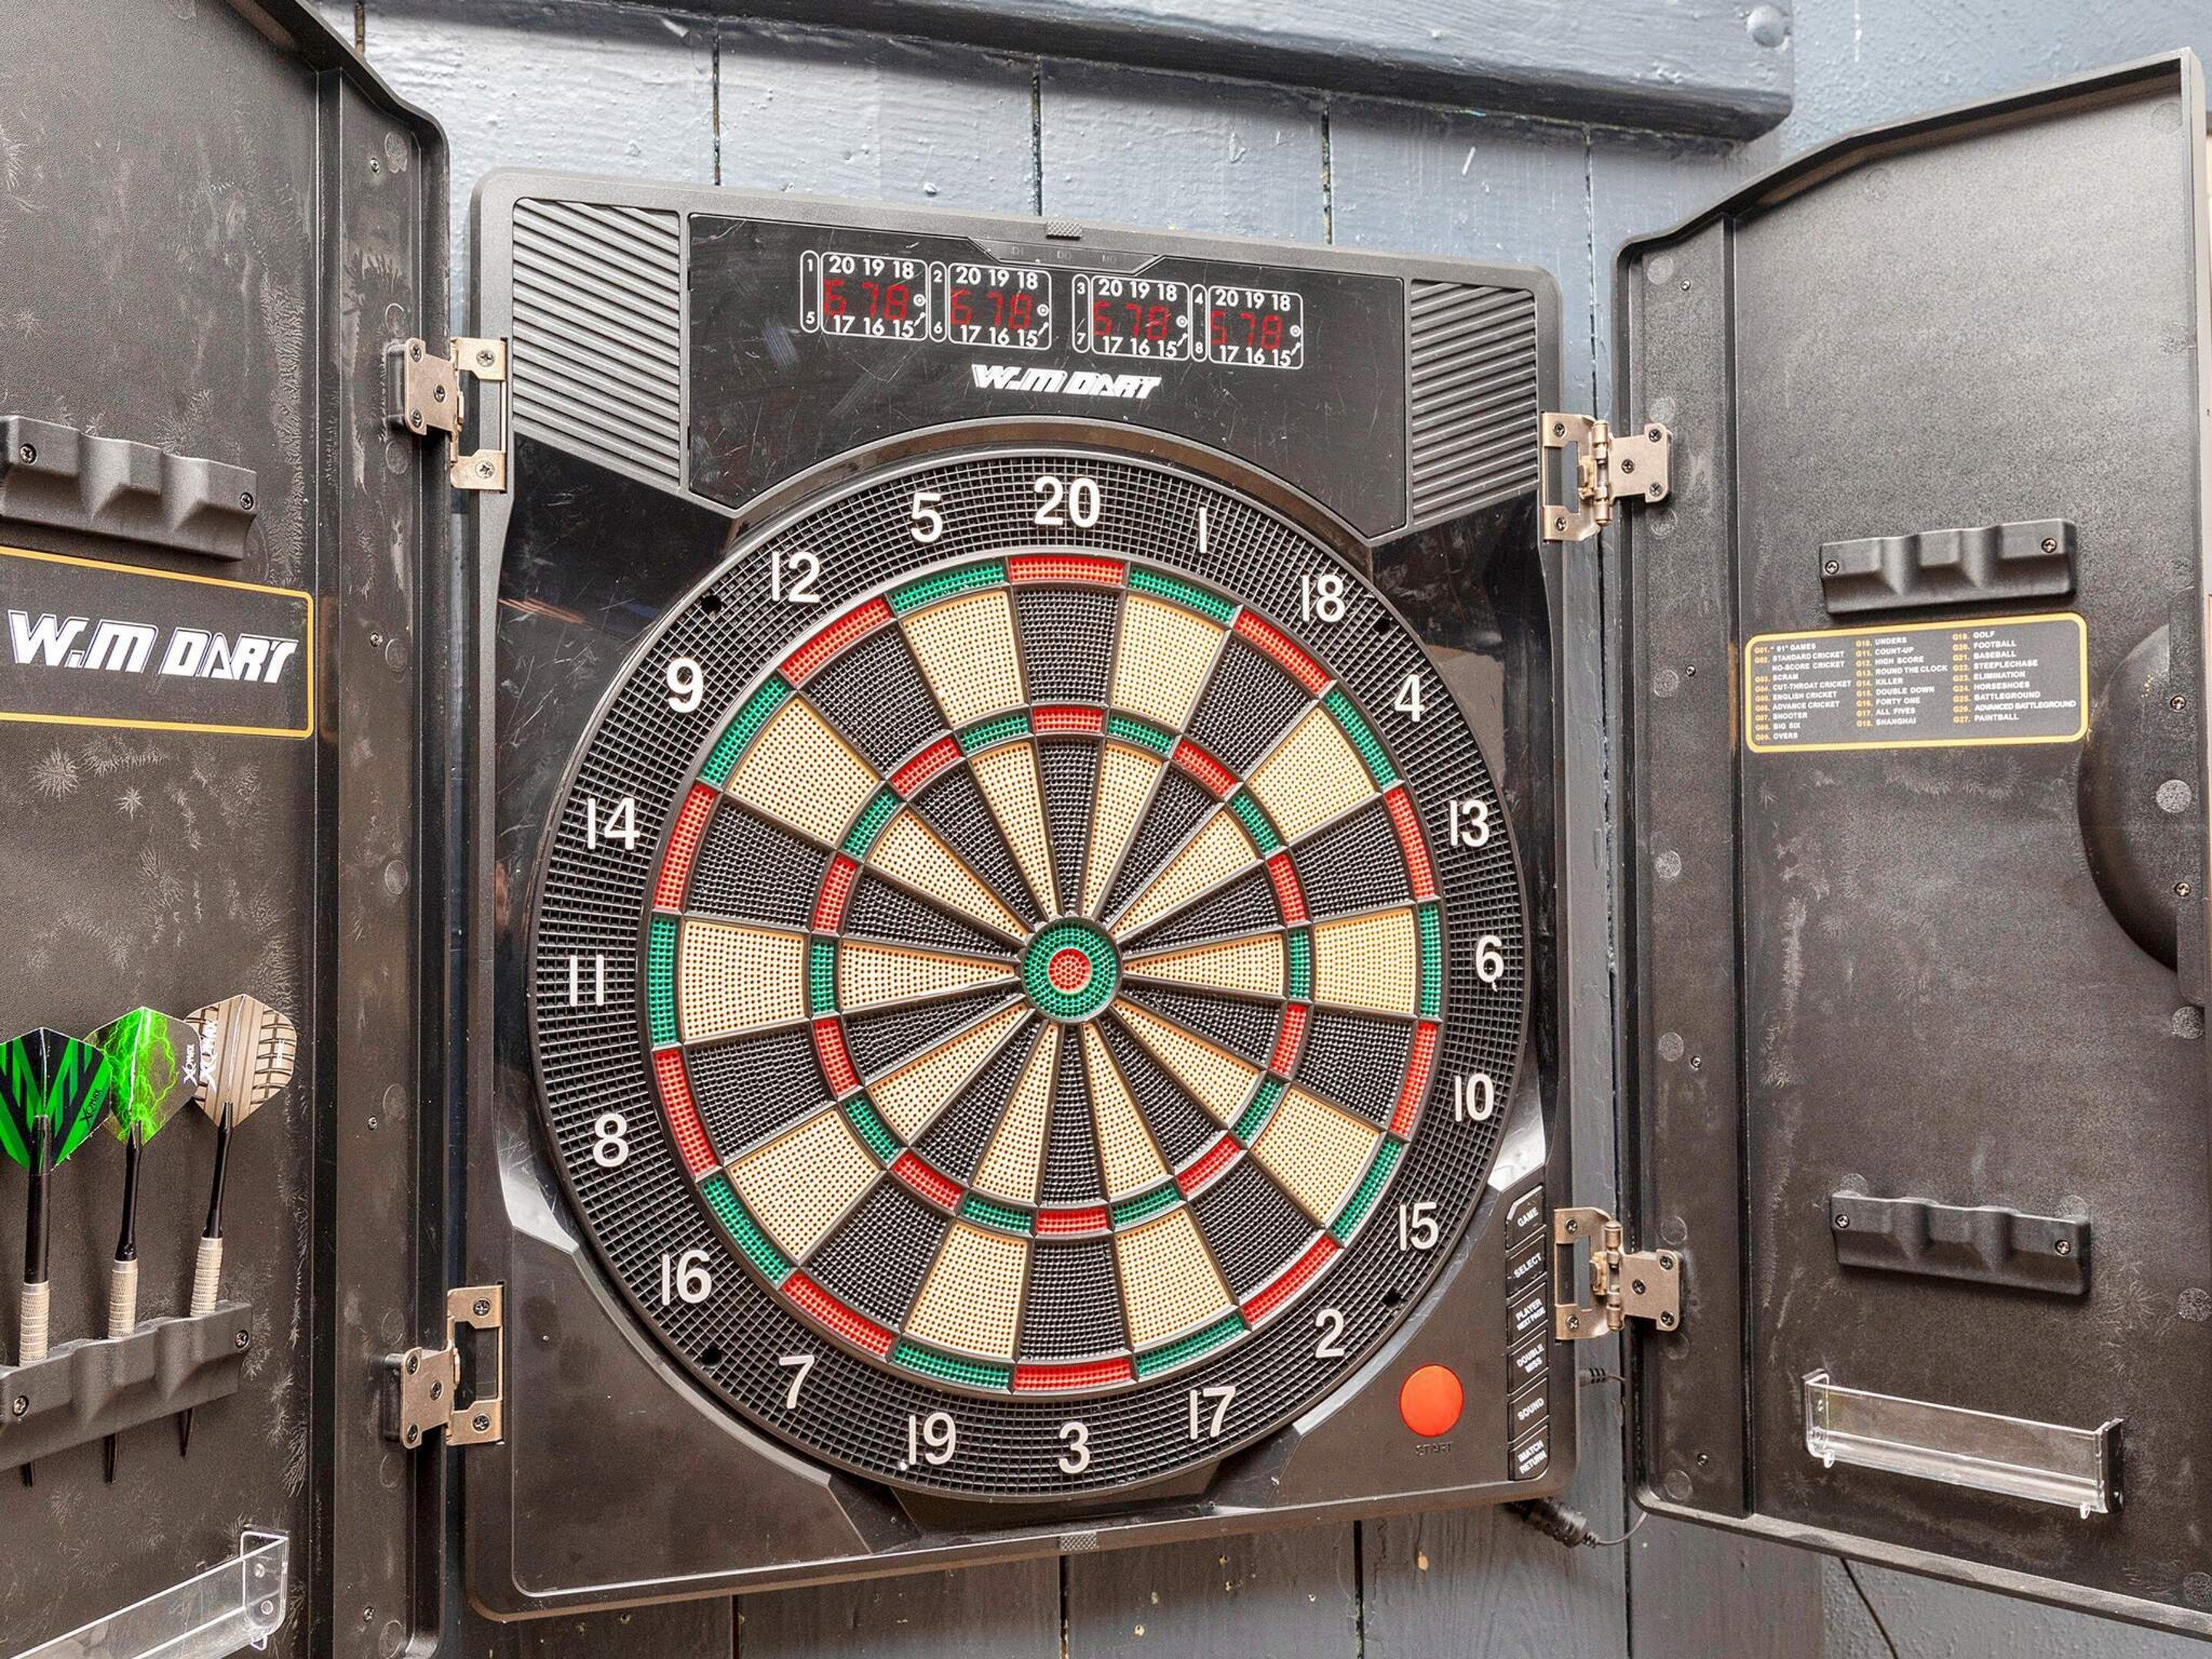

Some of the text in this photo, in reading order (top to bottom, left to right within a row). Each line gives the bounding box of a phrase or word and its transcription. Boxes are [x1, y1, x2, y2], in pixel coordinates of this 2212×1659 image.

[806, 259, 813, 272] 1
[829, 255, 914, 280] 20 19 18
[933, 270, 942, 283] 2
[955, 267, 1038, 290] 20 19 18
[1077, 282, 1086, 295] 3
[1098, 278, 1177, 302] 20 19 18
[1194, 293, 1204, 305] 4
[1215, 289, 1291, 312] 20 19 18
[806, 311, 815, 324] 5
[833, 315, 914, 338] 17 16 15
[933, 321, 943, 334] 6
[960, 324, 1038, 348] 17 16 15
[1077, 333, 1086, 345] 7
[1103, 336, 1177, 358] 17 16 15
[1195, 341, 1204, 354] 8
[1220, 345, 1291, 367] 17 16 15
[1033, 476, 1101, 528] 20
[910, 493, 943, 542] 5
[1199, 507, 1207, 554] 1
[771, 551, 820, 604] 12
[1302, 575, 1346, 622] 18
[1790, 643, 1816, 651] GAMES
[1875, 637, 1907, 645] UNDERS
[1875, 647, 1914, 655] COUNT-UP
[1973, 640, 2017, 649] FOOTBALL
[157, 627, 299, 684] DART
[1773, 654, 1811, 662] STANDARD
[1813, 651, 1844, 660] CRICKET
[1813, 661, 1845, 669] CRICKET
[1973, 651, 2017, 659] BASEBALL
[1973, 659, 2038, 670] STEEPLECHASE
[1876, 667, 1903, 675] ROUND
[1876, 677, 1903, 686] KILLER
[1973, 671, 2026, 680] ELIMINATION
[666, 657, 704, 713] 9
[1806, 690, 1837, 699] CRICKET
[1820, 680, 1852, 688] CRICKET
[1876, 687, 1907, 696] DOUBLE
[1973, 681, 2031, 690] HORSESHOES
[1394, 674, 1425, 722] 4
[1807, 700, 1840, 709] CRICKET
[1974, 691, 2041, 700] BATTLEGROUND
[1974, 702, 2014, 711] ADVANCED
[2015, 700, 2077, 710] BATTLEGROUND
[1876, 717, 1917, 726] SHANGHAI
[1892, 707, 1916, 715] FIVES
[1974, 713, 2020, 721] PAINTBALL
[587, 796, 640, 851] 14
[1450, 800, 1489, 847] 13
[1476, 935, 1504, 983] 6
[570, 955, 604, 1007] 11
[1454, 1074, 1494, 1122] 10
[592, 1113, 629, 1167] 8
[1399, 1201, 1438, 1251] 15
[1517, 1207, 1538, 1227] GAME
[1514, 1253, 1542, 1278] SELECT
[662, 1249, 713, 1306] 16
[1515, 1298, 1542, 1321] PLAYER
[1313, 1308, 1344, 1359] 2
[1516, 1344, 1545, 1367] DOUBLE
[777, 1355, 815, 1409] 7
[1190, 1386, 1236, 1440] 17
[1518, 1398, 1545, 1420] SOUND
[908, 1411, 956, 1465] 19
[1058, 1422, 1091, 1475] 3
[1519, 1450, 1547, 1474] RETURN
